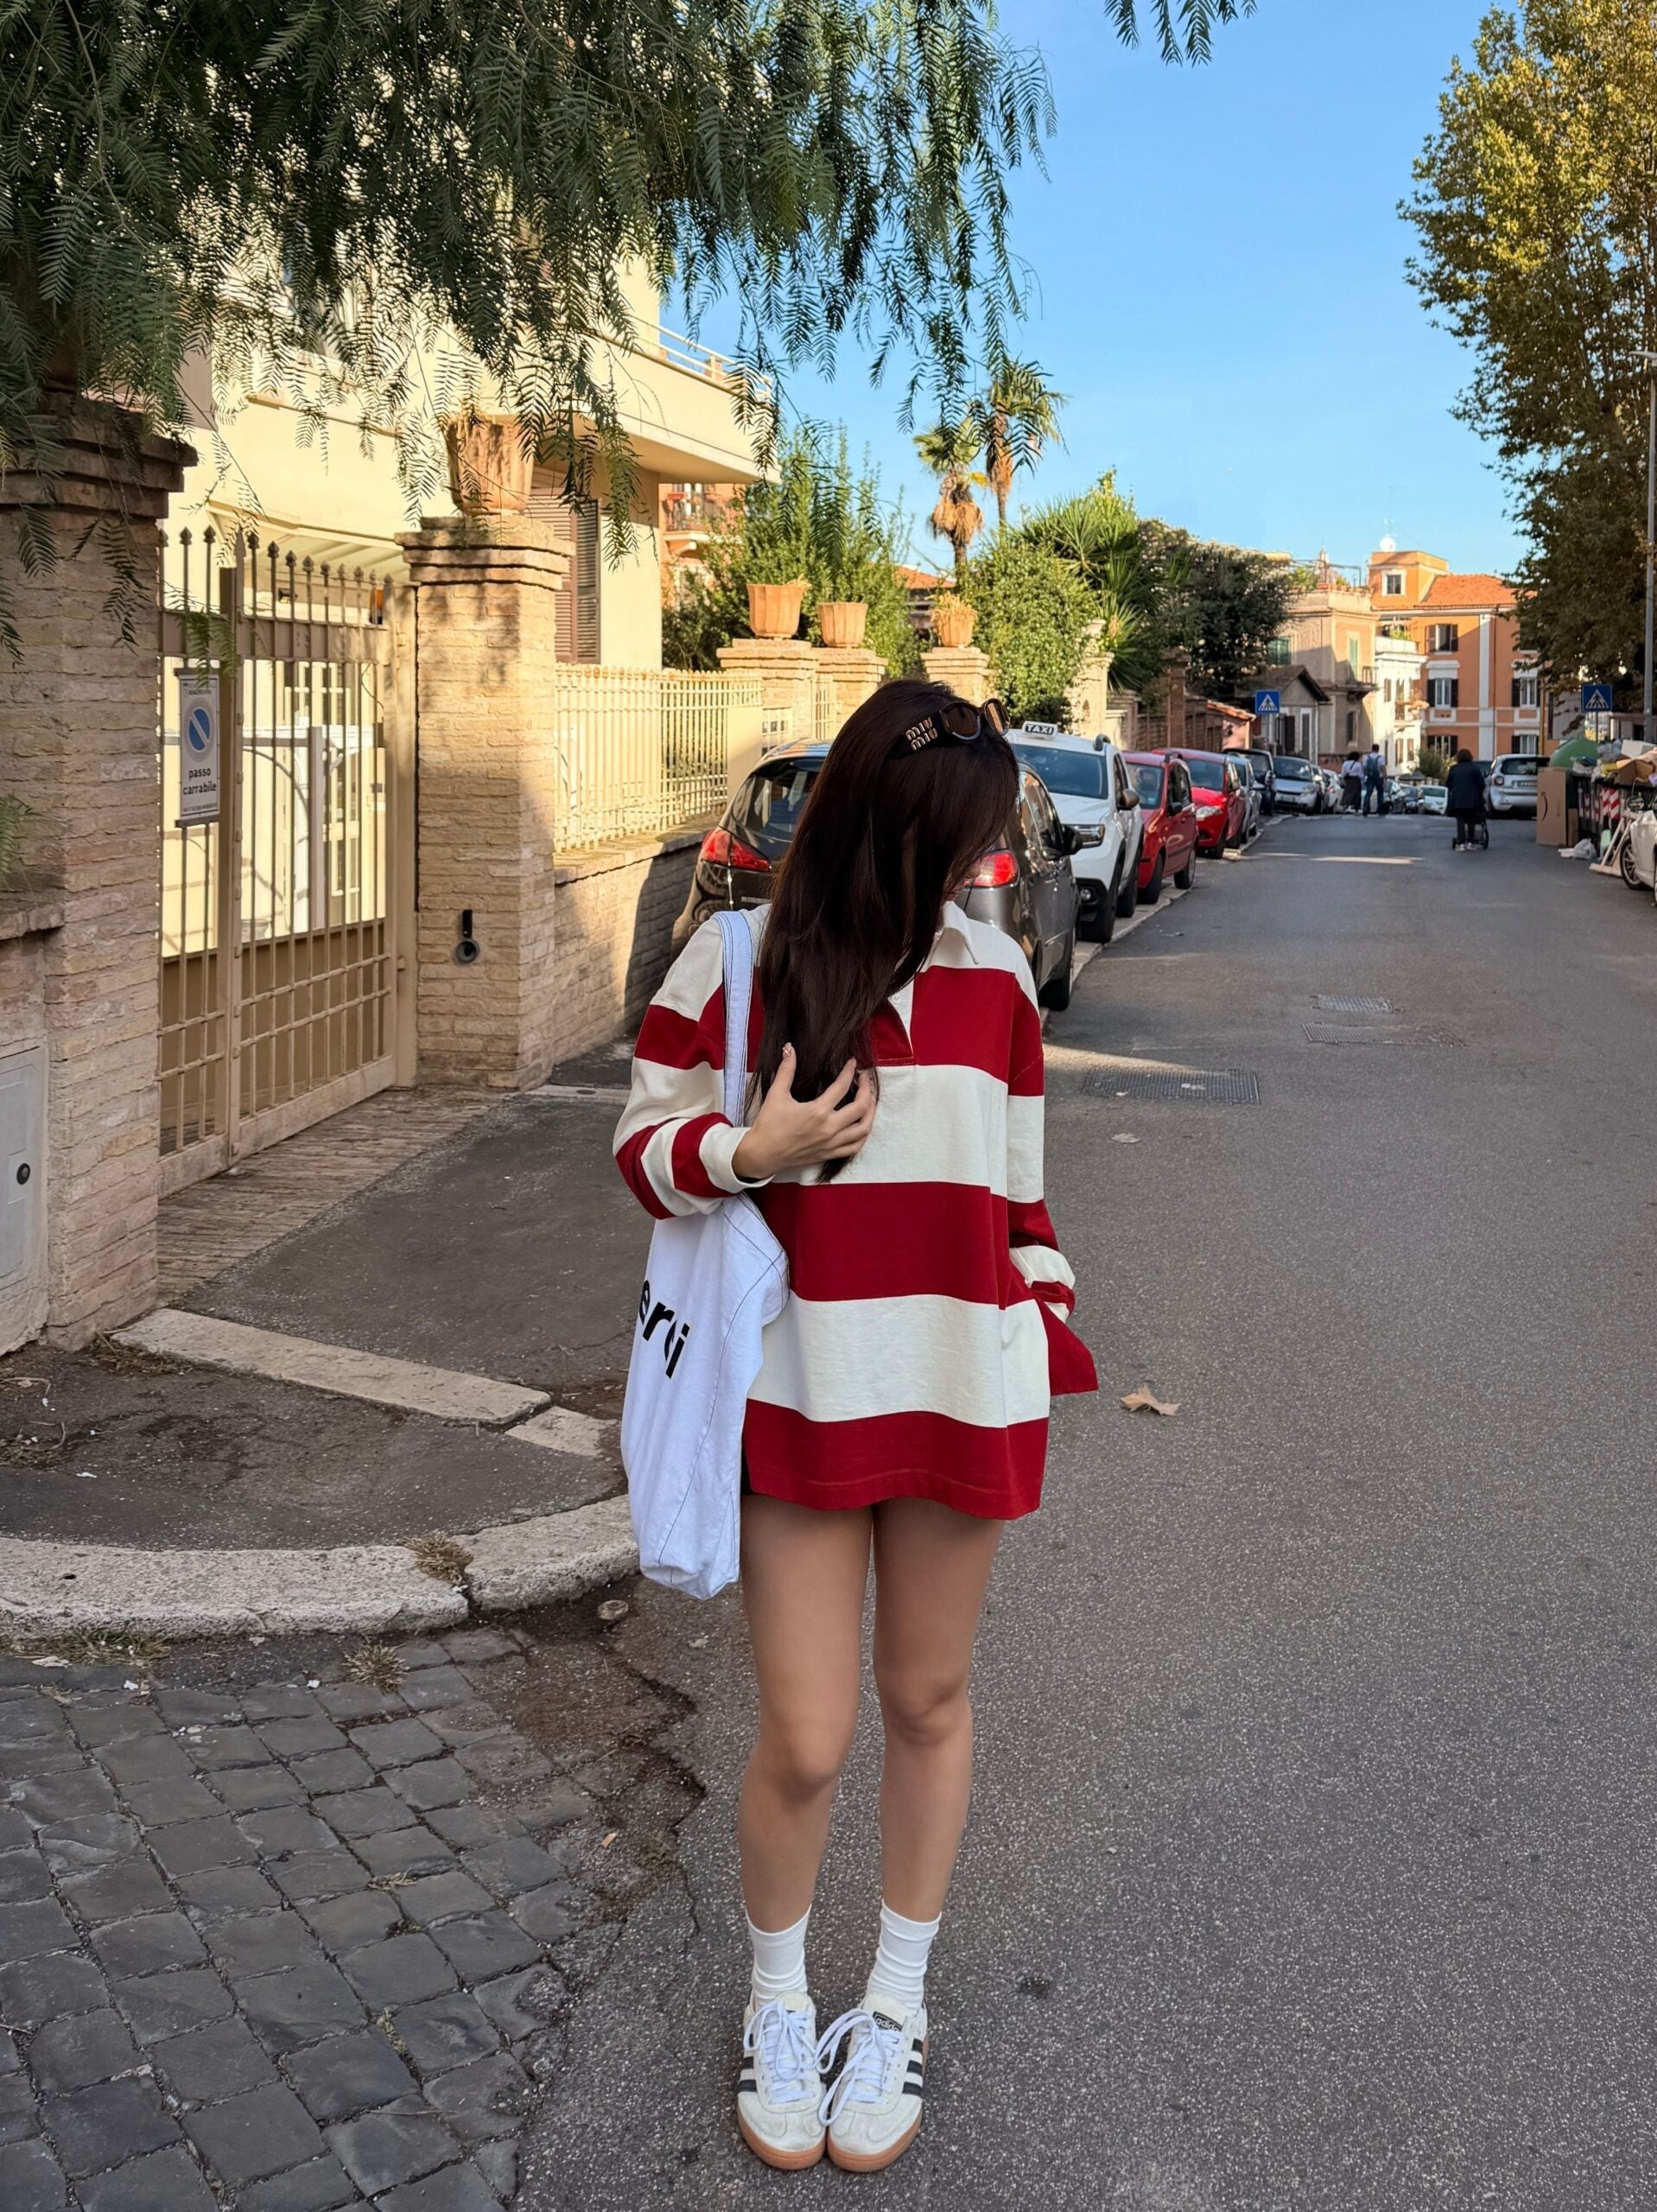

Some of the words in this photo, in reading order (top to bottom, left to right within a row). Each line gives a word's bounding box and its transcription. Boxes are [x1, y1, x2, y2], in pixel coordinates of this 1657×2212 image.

[905, 716, 933, 741] miu
[1026, 724, 1053, 734] TAXI
[911, 728, 938, 751] miu
[188, 767, 212, 781] passo
[183, 781, 217, 795] carrabile
[875, 2017, 900, 2031] adida
